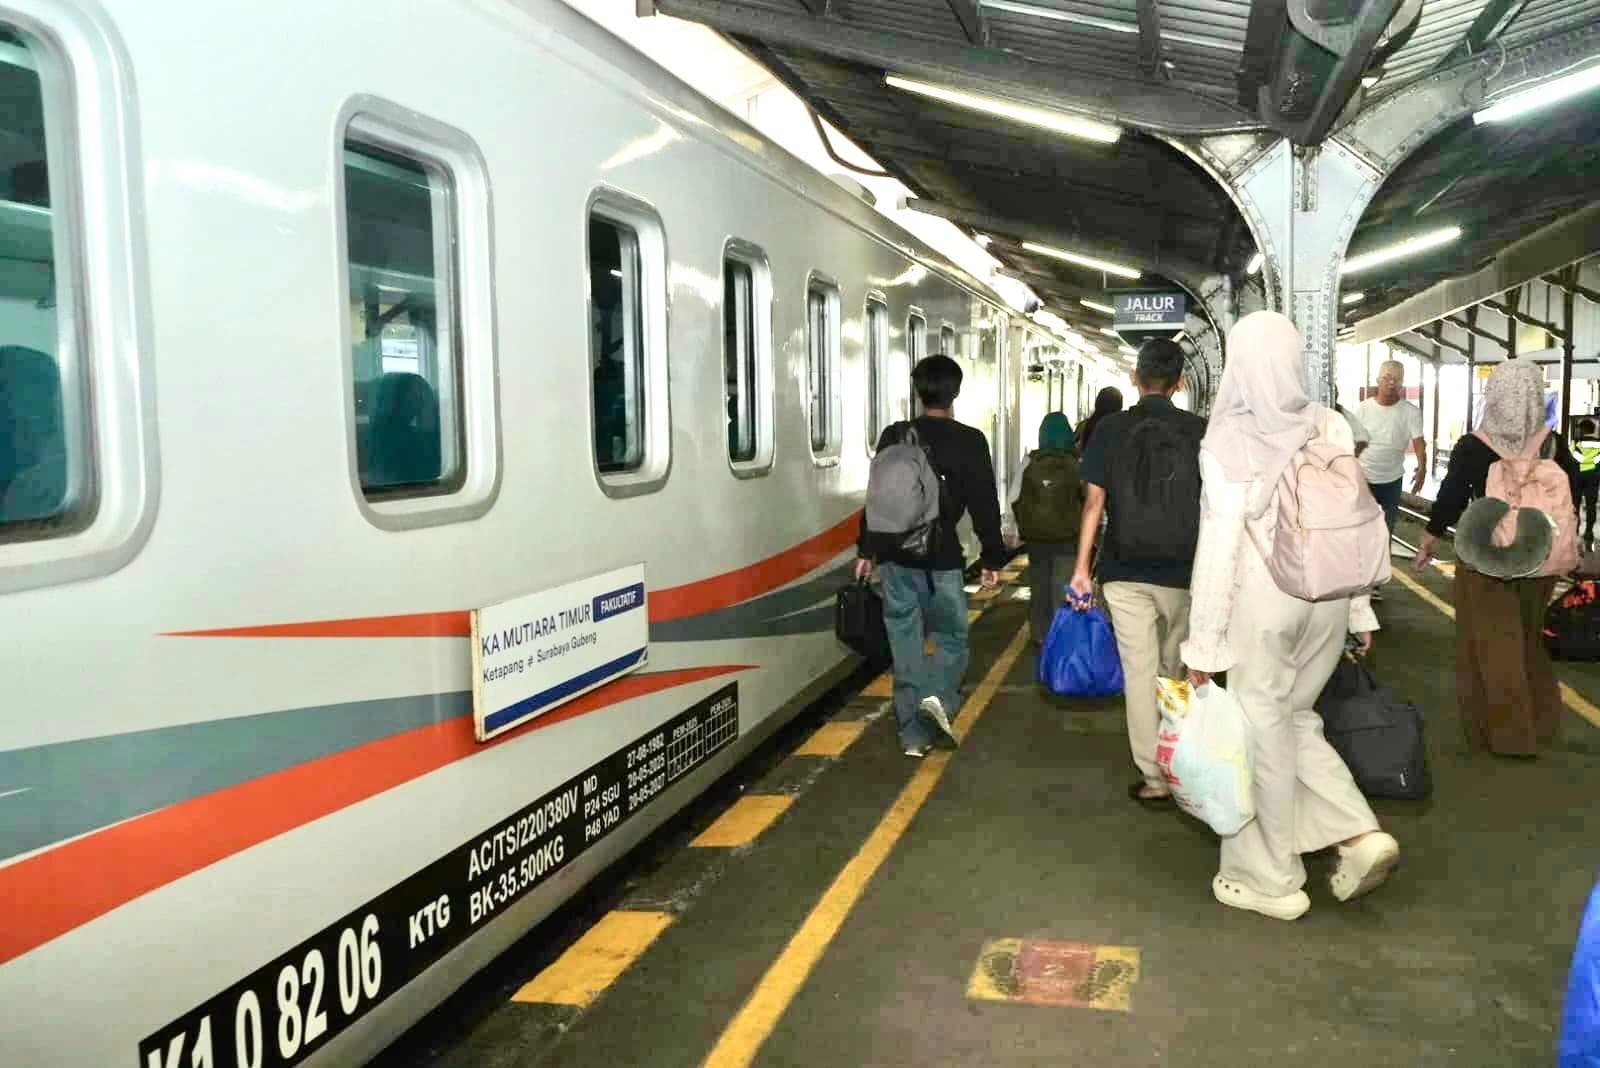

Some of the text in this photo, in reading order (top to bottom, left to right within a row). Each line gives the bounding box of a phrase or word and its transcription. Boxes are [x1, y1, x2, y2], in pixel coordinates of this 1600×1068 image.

[1124, 296, 1175, 311] JALUR
[1135, 313, 1164, 321] TRACK
[600, 590, 637, 615] FAKULTATIF
[481, 604, 591, 657] KA MUTIARA TIMUR
[483, 631, 597, 683] Ketapang Surabaya Gubeng
[583, 775, 598, 796] MD
[584, 795, 600, 819] P24
[601, 782, 620, 807] SGU
[467, 786, 578, 882] AC/TS/220/380V
[585, 819, 601, 842] P48
[602, 806, 620, 829] YAD
[469, 835, 564, 925] BK-35.500KG
[408, 894, 450, 949] KTG
[235, 989, 263, 1068] 0
[277, 949, 328, 1060] 82
[338, 913, 382, 1016] 06
